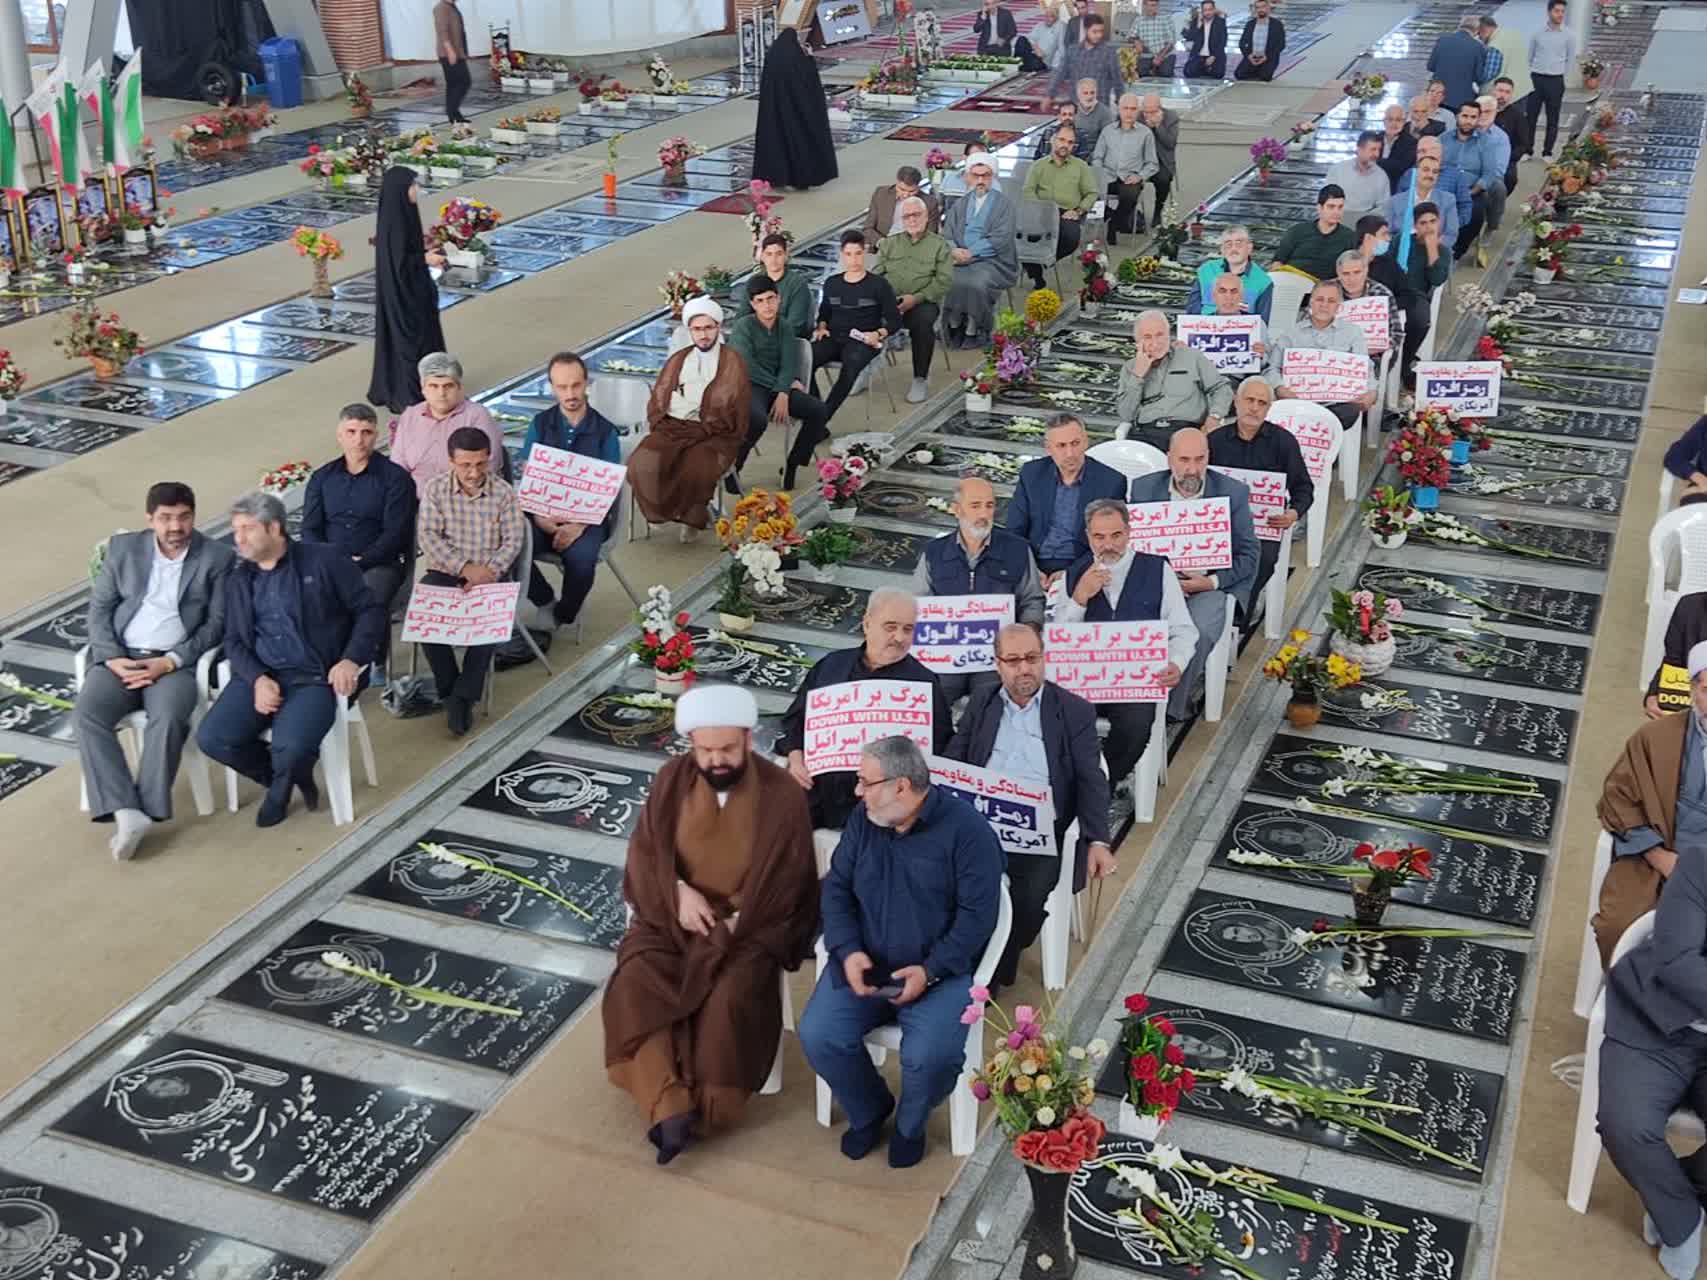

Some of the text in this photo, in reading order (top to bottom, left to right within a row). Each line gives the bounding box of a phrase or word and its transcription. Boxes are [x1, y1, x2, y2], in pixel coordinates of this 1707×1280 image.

[1191, 335, 1247, 352] رمز افول
[1429, 381, 1487, 398] رمز افول
[1454, 398, 1494, 413] آمریکای
[534, 447, 577, 470] آمریکا
[1252, 476, 1281, 494] مرگ
[1129, 503, 1226, 525] مرگ بر آمریک
[1181, 542, 1193, 556] بر
[1196, 538, 1229, 554] مرگ
[920, 602, 945, 619] مقاو
[955, 600, 1009, 618] ایستادگی
[917, 621, 996, 645] رمز افول
[1047, 623, 1165, 649] مرگ بر آمریکا
[1111, 670, 1125, 686] بر
[1129, 665, 1160, 685] مرگ
[811, 683, 928, 712] مرگ بر آمریکا
[1658, 693, 1690, 705] DOW
[852, 711, 888, 722] WITH
[806, 727, 867, 757] اسرائیل
[975, 779, 985, 791] و
[985, 778, 1048, 801] ایستادگی
[990, 804, 1031, 829] رمز
[999, 828, 1049, 850] آمریکا
